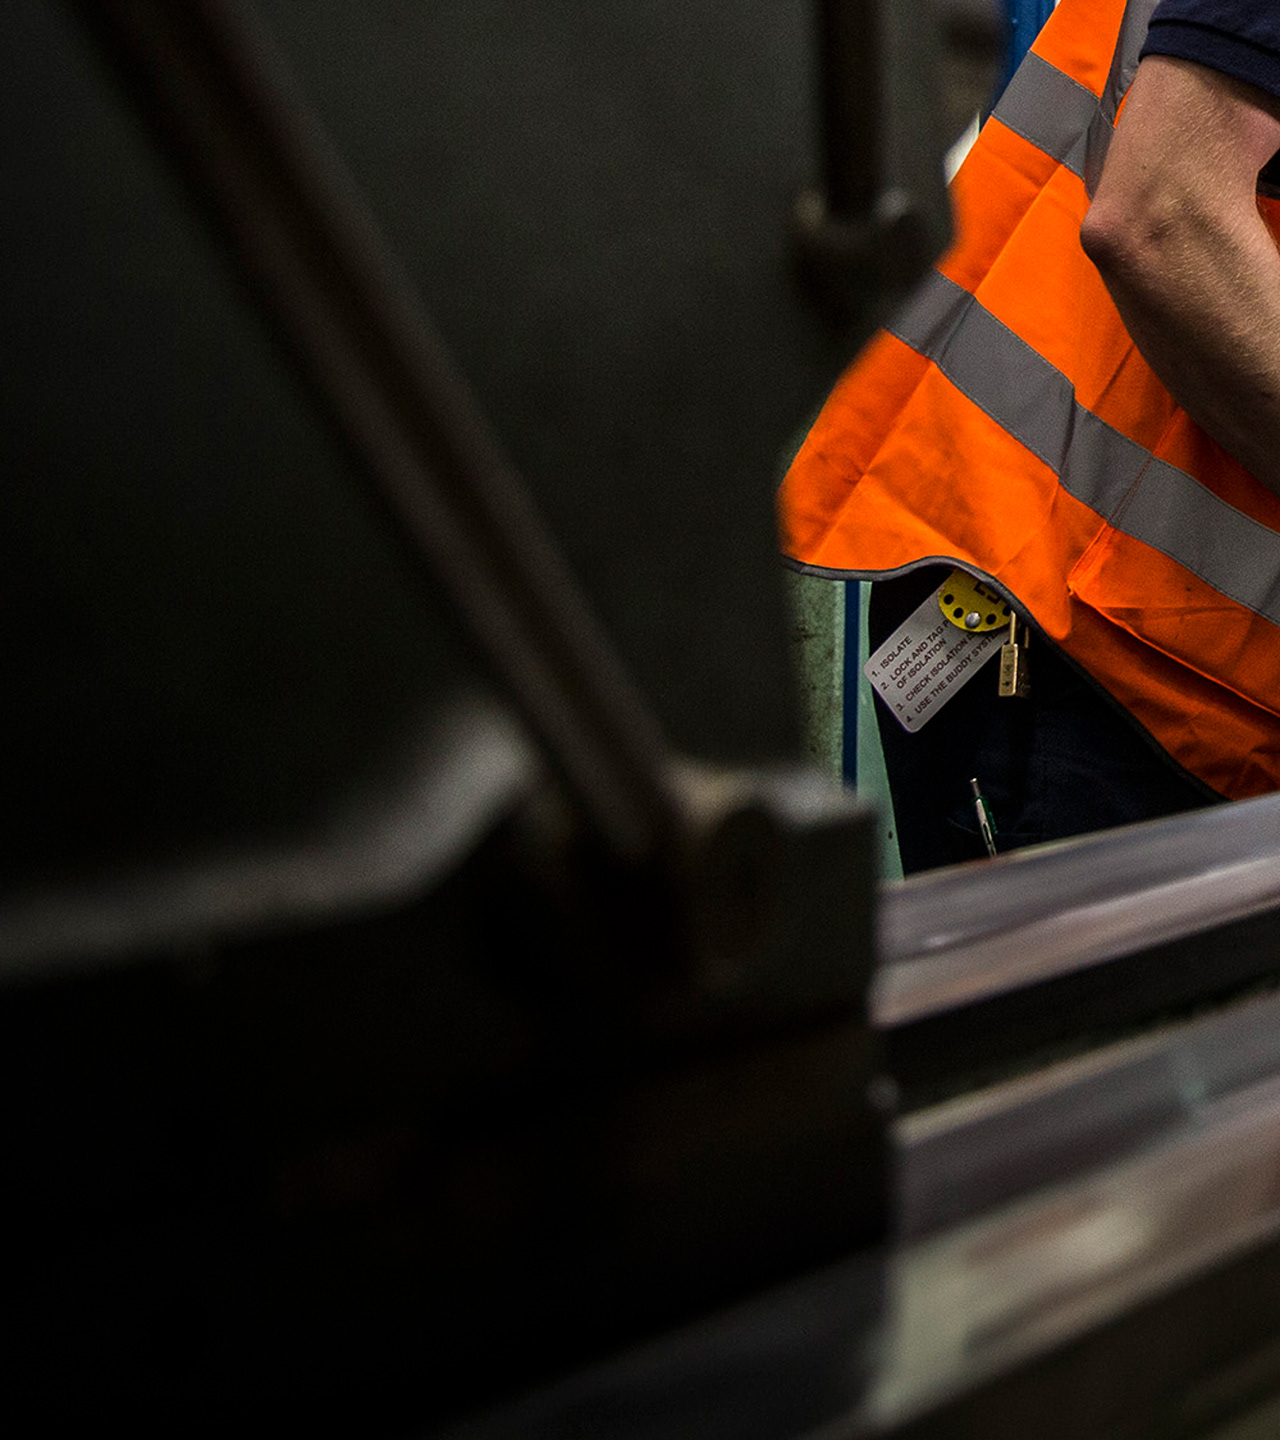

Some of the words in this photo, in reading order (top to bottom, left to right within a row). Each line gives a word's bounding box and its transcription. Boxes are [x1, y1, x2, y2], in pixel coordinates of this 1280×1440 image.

[880, 636, 913, 669] ISOLATE
[890, 657, 912, 681] LOCK
[912, 641, 929, 660] AND
[926, 625, 944, 644] TAG
[896, 674, 909, 689] OF
[908, 638, 947, 678] ISOLATION
[905, 674, 932, 702] CHECK
[930, 638, 968, 677] ISOLATION
[914, 695, 933, 714] USE
[930, 680, 948, 699] THE
[945, 654, 973, 683] BUDDY
